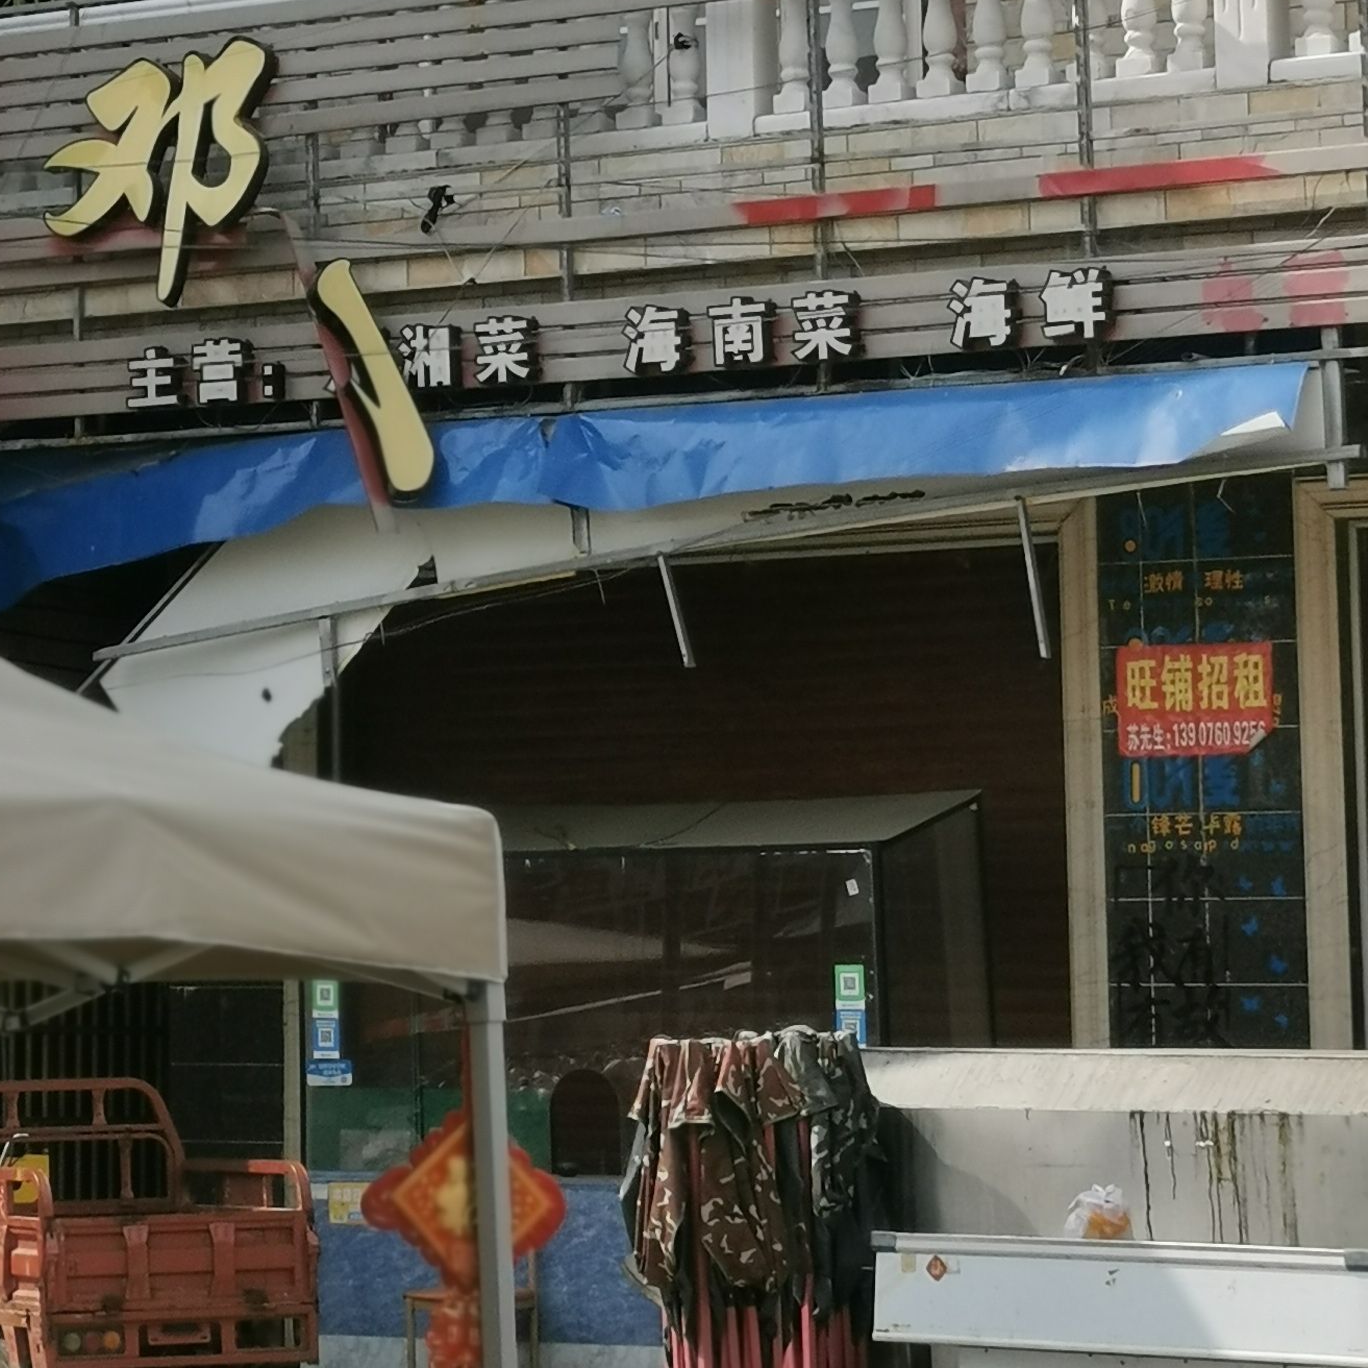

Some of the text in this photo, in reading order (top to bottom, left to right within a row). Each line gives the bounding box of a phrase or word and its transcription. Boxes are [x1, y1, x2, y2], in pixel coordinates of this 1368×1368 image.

[127, 268, 1107, 408] 主营： 湘菜 海南菜 海鲜
[1204, 568, 1244, 591] 理性
[1126, 652, 1268, 712] 旺铺招租
